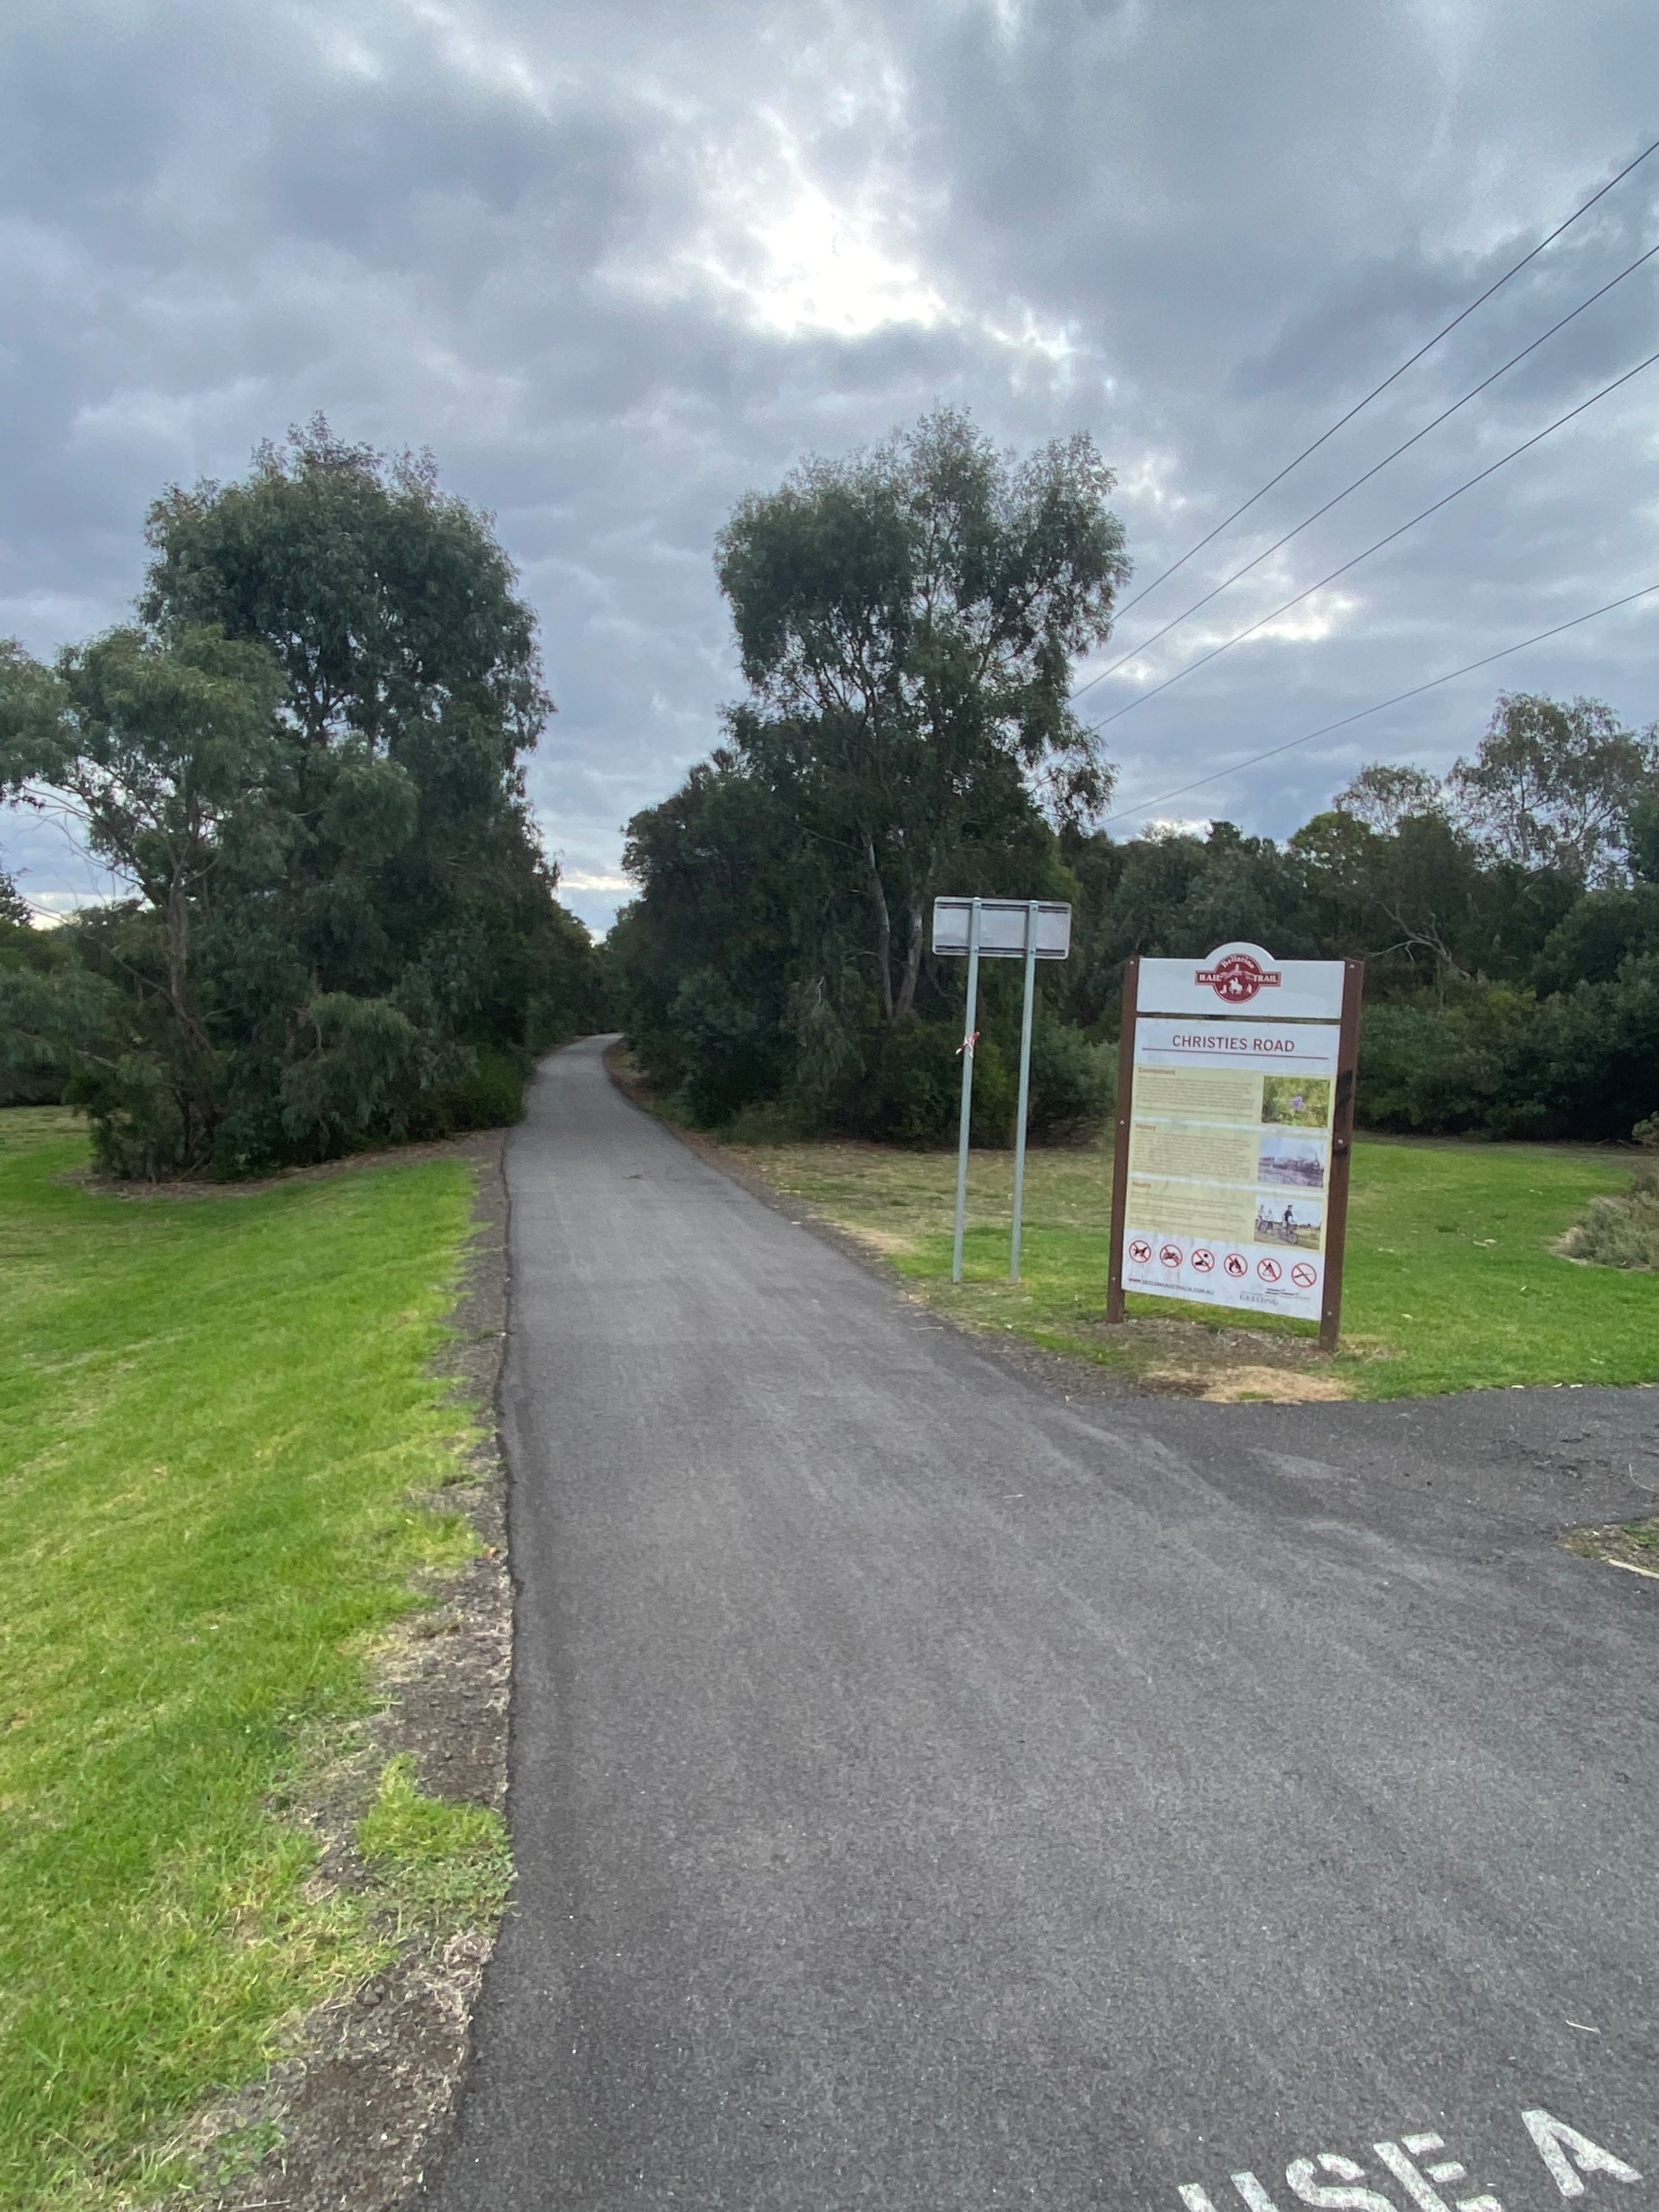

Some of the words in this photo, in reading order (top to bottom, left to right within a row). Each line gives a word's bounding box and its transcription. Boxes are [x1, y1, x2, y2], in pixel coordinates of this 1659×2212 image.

[1173, 1035, 1248, 1050] CHRISTIES
[1253, 1039, 1294, 1052] ROAD
[1522, 2109, 1643, 2197] A
